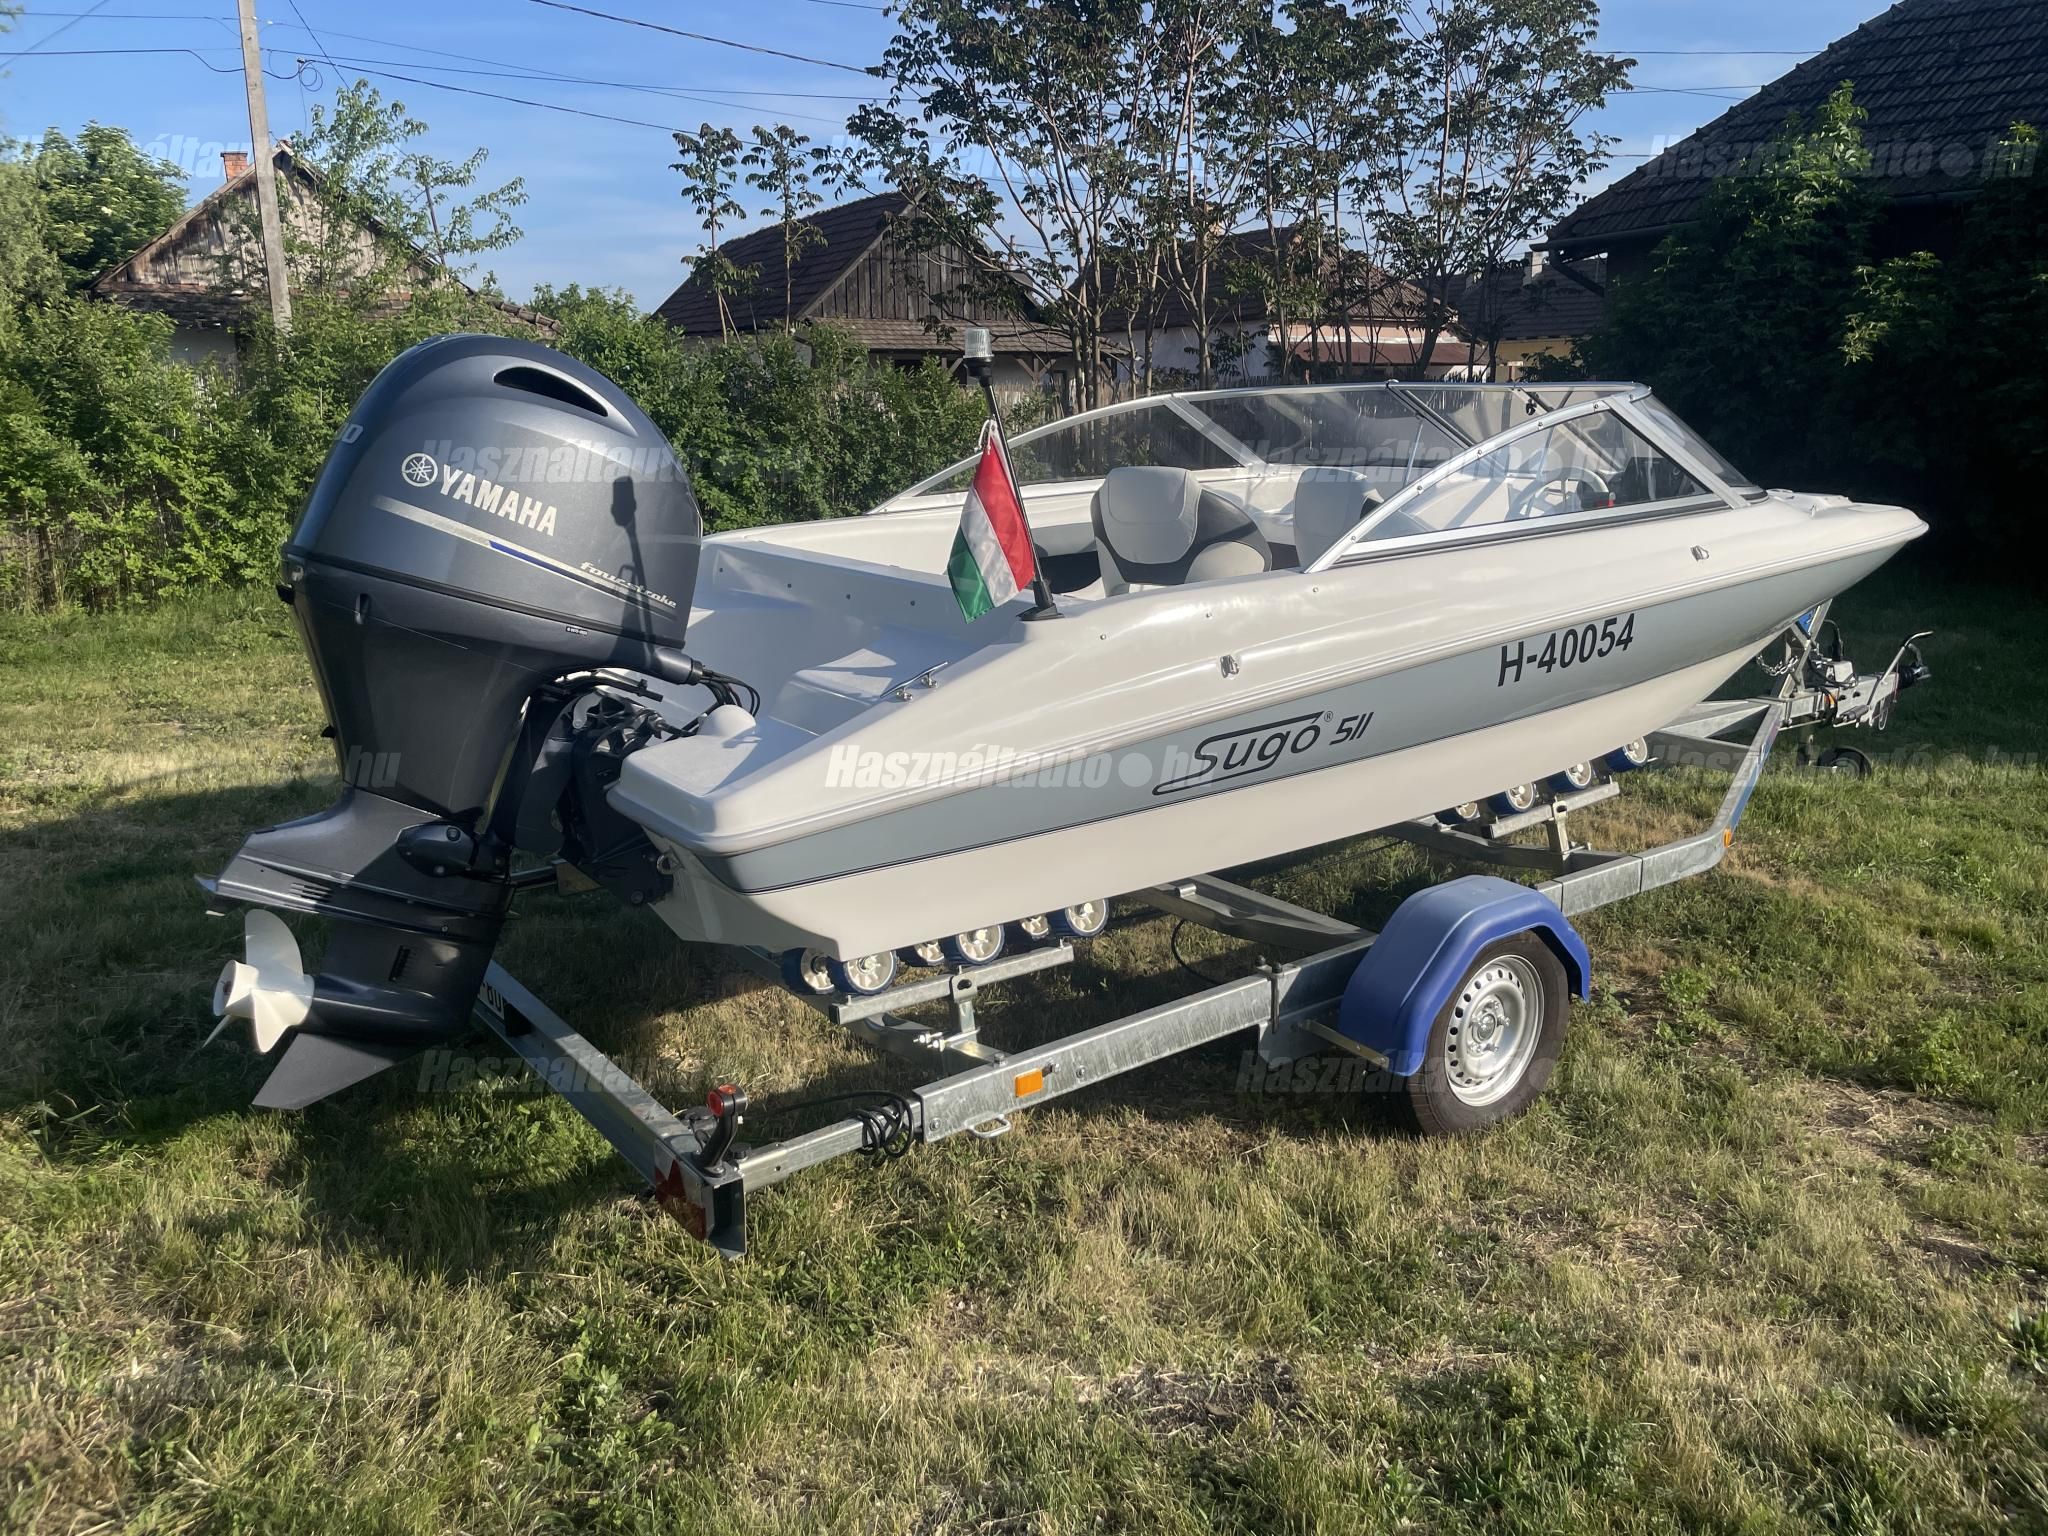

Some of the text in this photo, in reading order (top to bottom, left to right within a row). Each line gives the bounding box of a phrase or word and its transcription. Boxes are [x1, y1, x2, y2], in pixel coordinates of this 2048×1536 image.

[440, 463, 558, 537] YAMAHA
[1497, 612, 1635, 688] H-40054
[1152, 710, 1325, 796] Sugó
